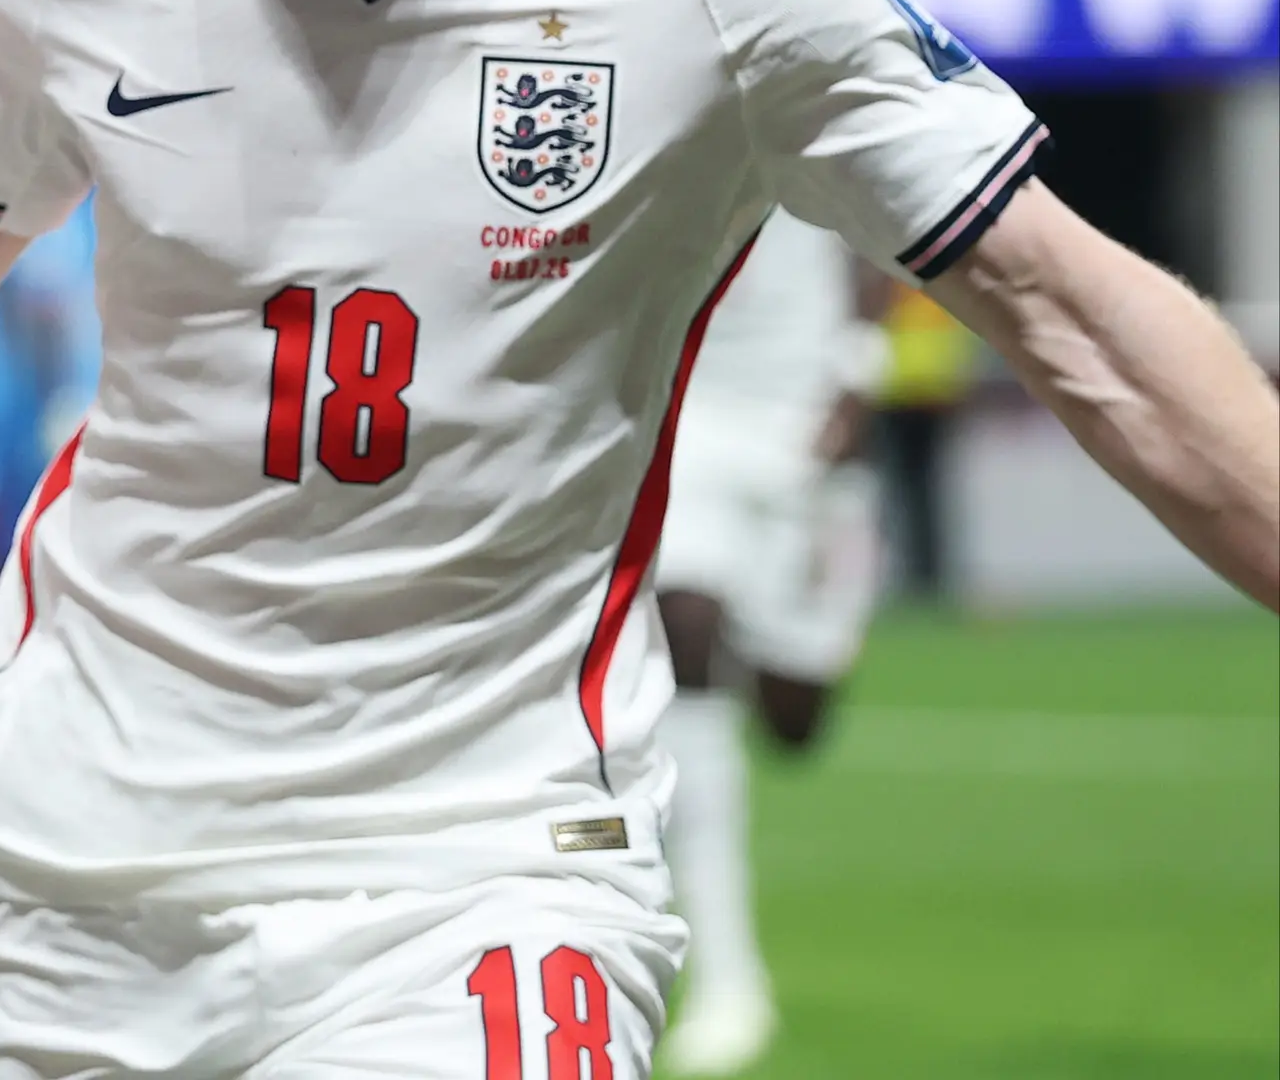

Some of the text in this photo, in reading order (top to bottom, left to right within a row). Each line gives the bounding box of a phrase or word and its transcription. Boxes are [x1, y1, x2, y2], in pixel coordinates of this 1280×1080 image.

[481, 225, 558, 250] CONGO
[263, 285, 419, 485] 18
[466, 944, 614, 1080] 18
